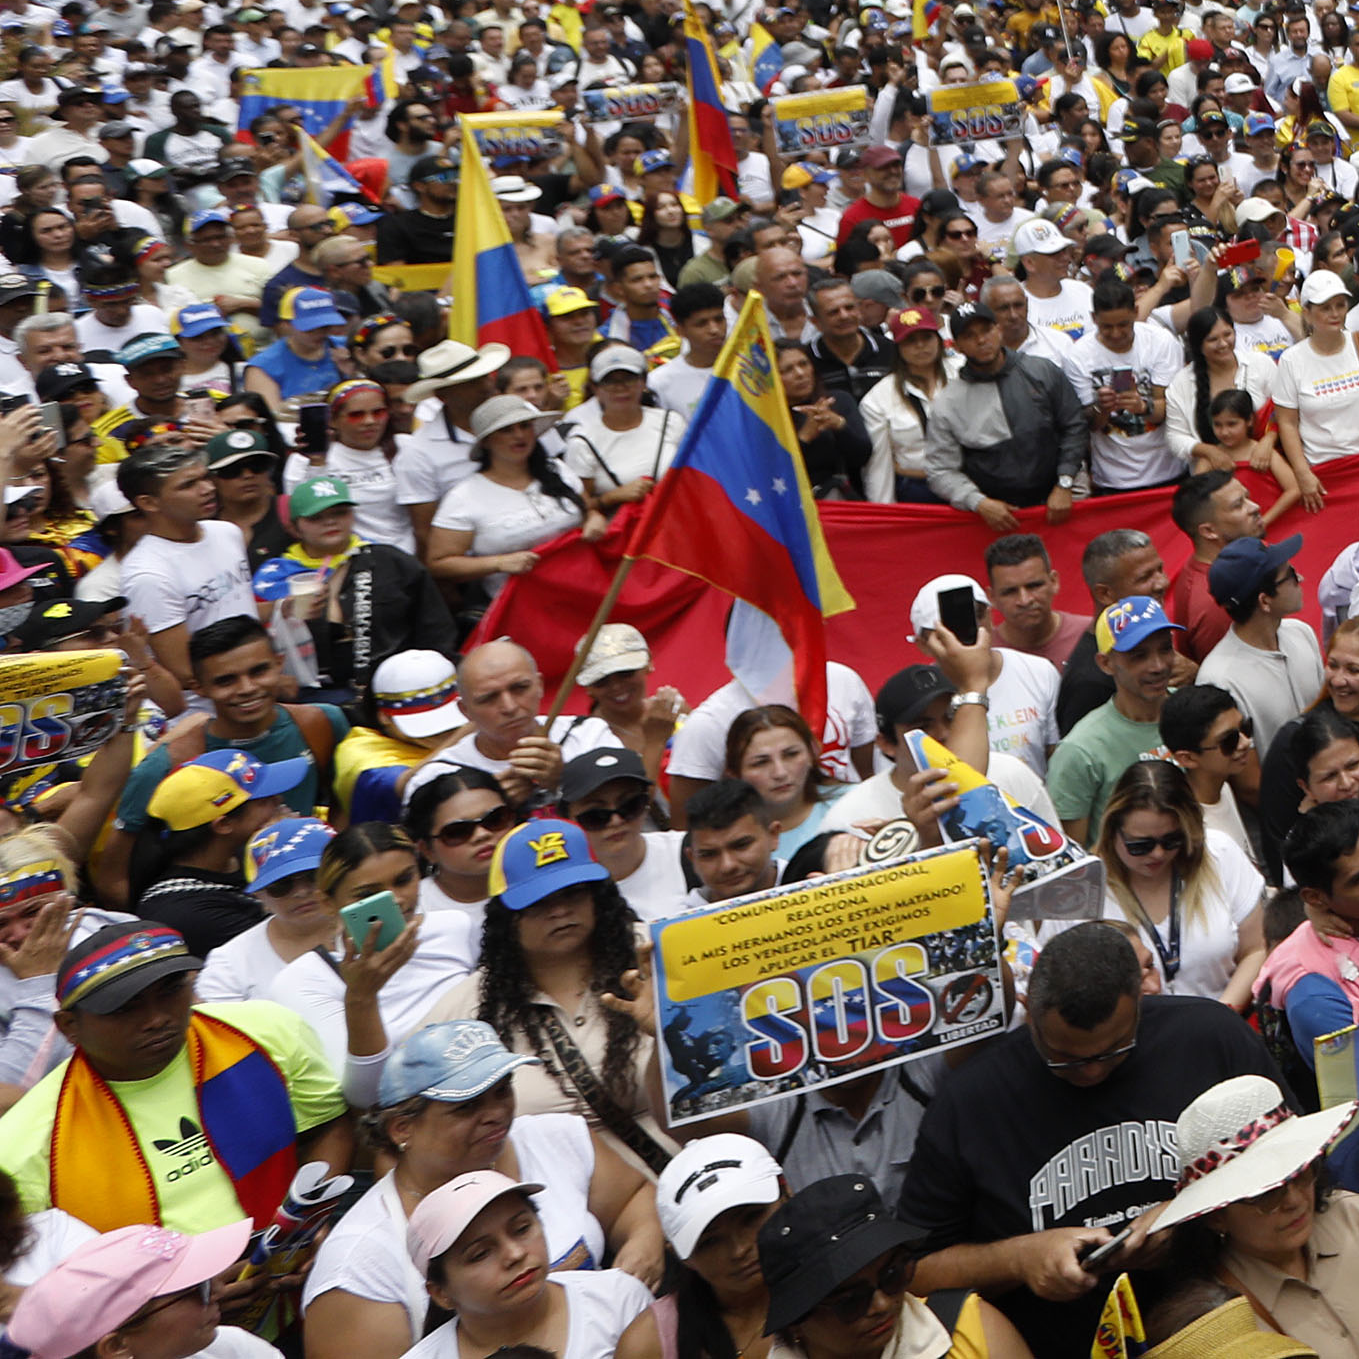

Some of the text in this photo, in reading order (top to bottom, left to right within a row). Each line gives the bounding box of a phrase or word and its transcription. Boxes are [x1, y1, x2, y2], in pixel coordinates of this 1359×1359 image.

[798, 116, 850, 149] SOS
[951, 109, 1003, 140] SOS
[997, 706, 1038, 731] KLEIN
[992, 732, 1030, 751] YORK
[702, 945, 727, 961] MIS
[732, 923, 813, 952] HERMANOS
[817, 915, 843, 930] LOS
[849, 903, 891, 922] ESTAN
[895, 883, 966, 909] MATANDO!
[786, 896, 869, 923] REACCIONA
[722, 906, 931, 971] LOS VENEZOLANOS EXIGIMOS
[759, 950, 817, 975] APLICAR
[821, 946, 837, 959] EL
[740, 942, 936, 1082] SOS
[939, 1018, 1001, 1043] LIBERTAD
[1029, 1120, 1182, 1233] PARADIS
